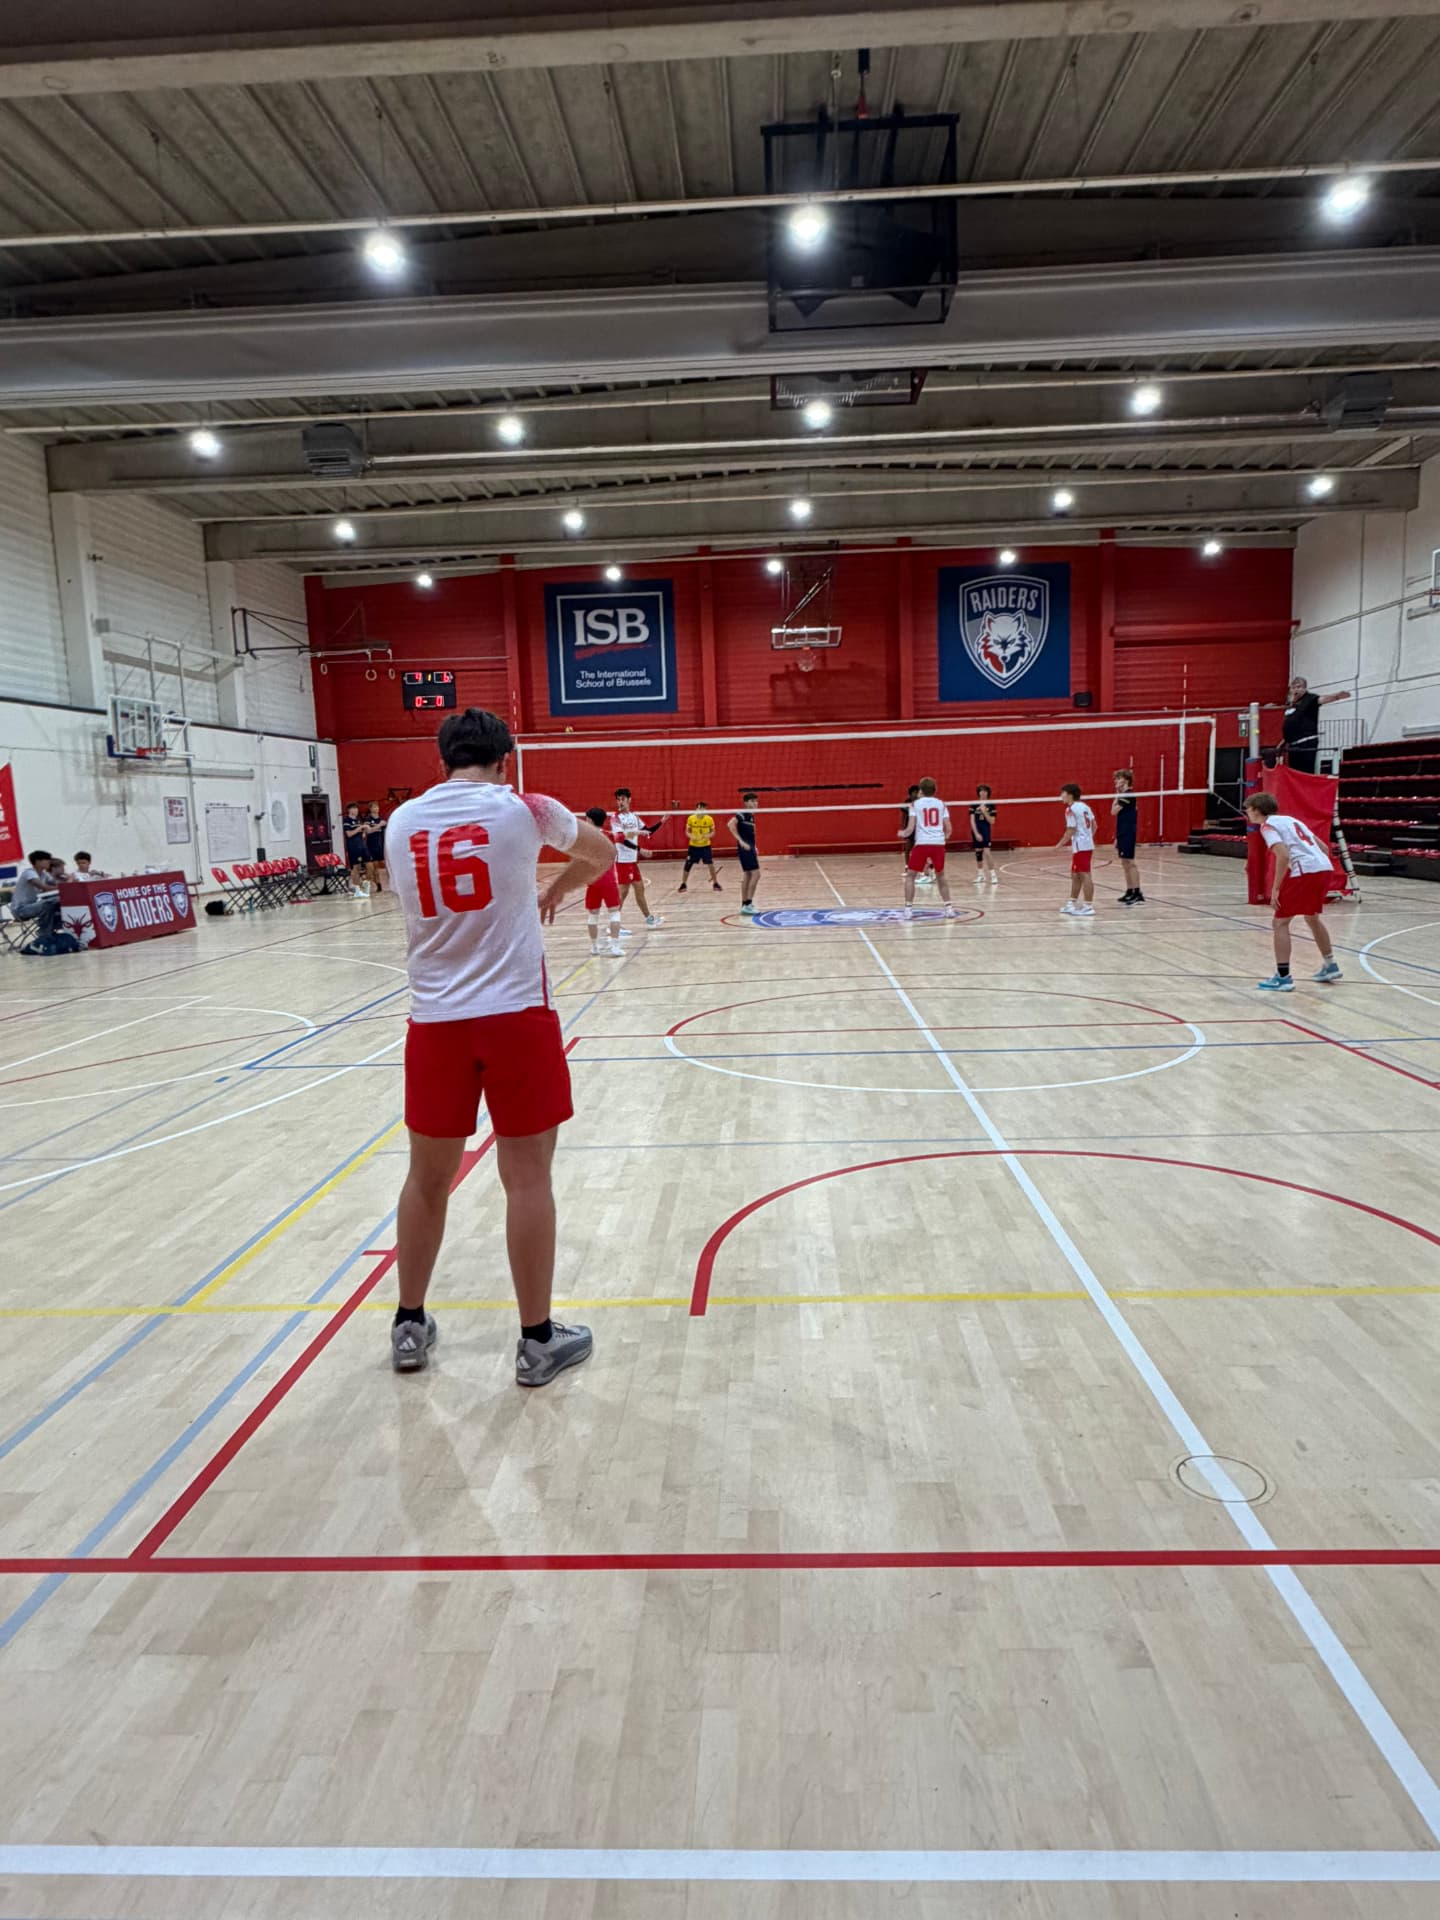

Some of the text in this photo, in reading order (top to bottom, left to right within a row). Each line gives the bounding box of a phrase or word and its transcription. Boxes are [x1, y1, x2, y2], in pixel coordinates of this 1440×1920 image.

[969, 586, 1039, 613] RAIDERS
[572, 607, 650, 646] ISB
[575, 677, 652, 689] School of Brussels
[580, 668, 647, 680] The International
[922, 807, 940, 827] 10
[1292, 821, 1315, 847] 4
[409, 823, 494, 919] 16
[116, 886, 142, 900] HOME
[141, 884, 152, 896] OF
[153, 882, 168, 894] THE
[119, 893, 175, 930] RAIDERS
